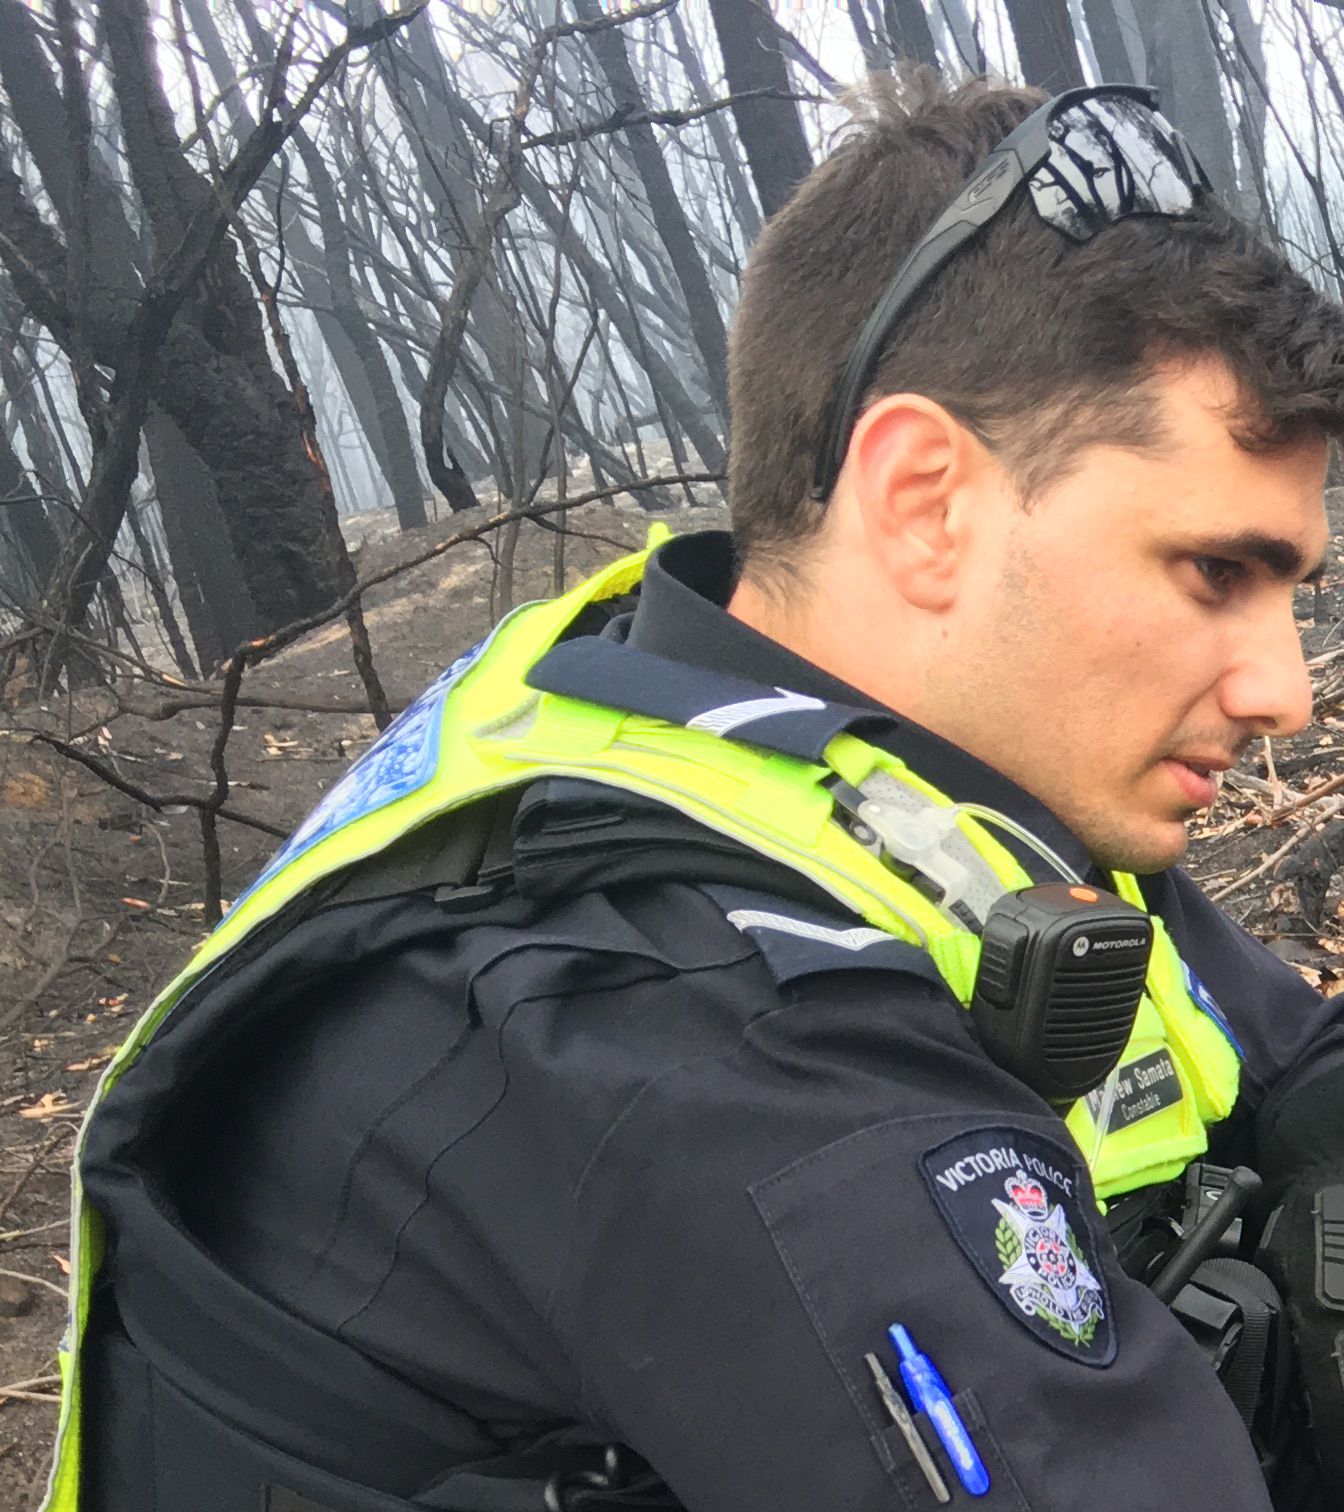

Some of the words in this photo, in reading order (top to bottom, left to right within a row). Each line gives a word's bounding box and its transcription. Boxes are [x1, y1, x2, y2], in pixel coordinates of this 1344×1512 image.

[1092, 938, 1147, 950] MOTOROLA
[1133, 1058, 1174, 1090] Samata
[1121, 1092, 1161, 1121] Constable
[936, 1147, 1023, 1192] VICTORIA
[1023, 1153, 1072, 1198] POLICE
